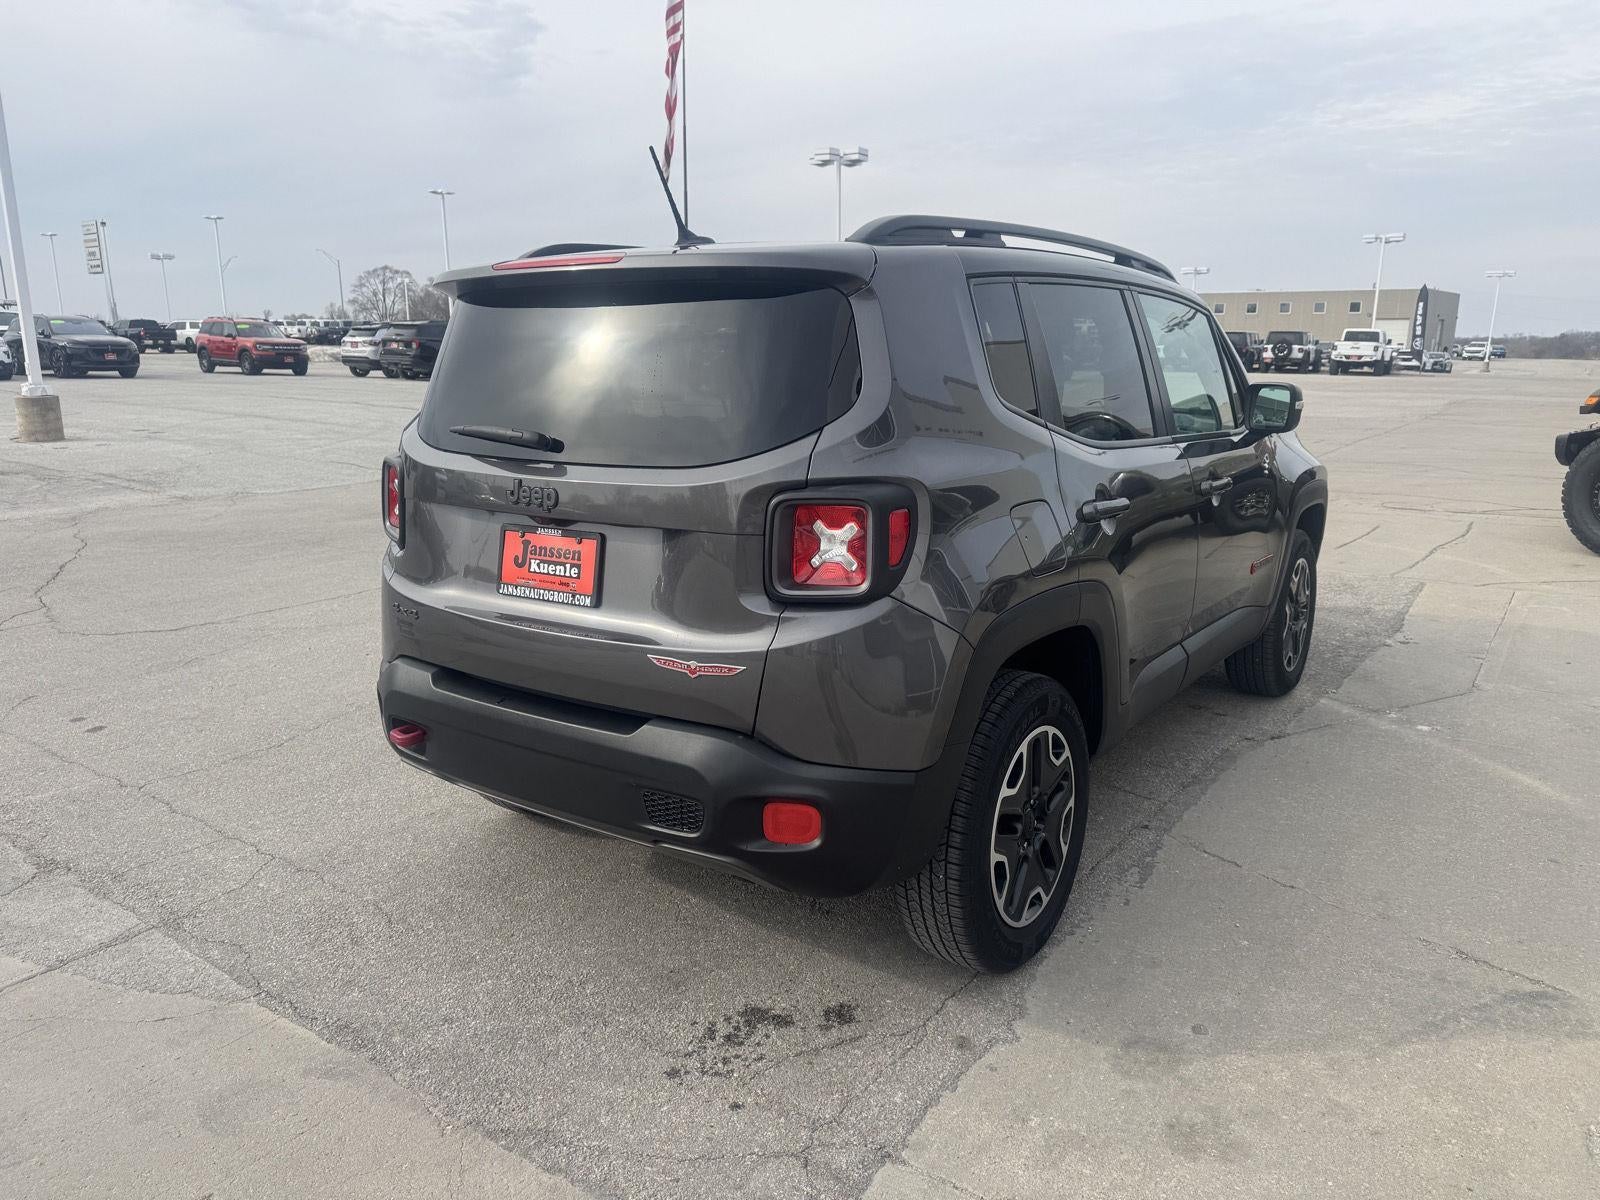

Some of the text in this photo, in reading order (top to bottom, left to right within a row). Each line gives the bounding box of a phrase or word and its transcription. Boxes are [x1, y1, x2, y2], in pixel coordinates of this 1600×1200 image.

[506, 479, 559, 513] Jeep
[536, 527, 562, 536] JANSSEN
[514, 539, 581, 568] Janssen
[529, 559, 578, 578] Kuenle
